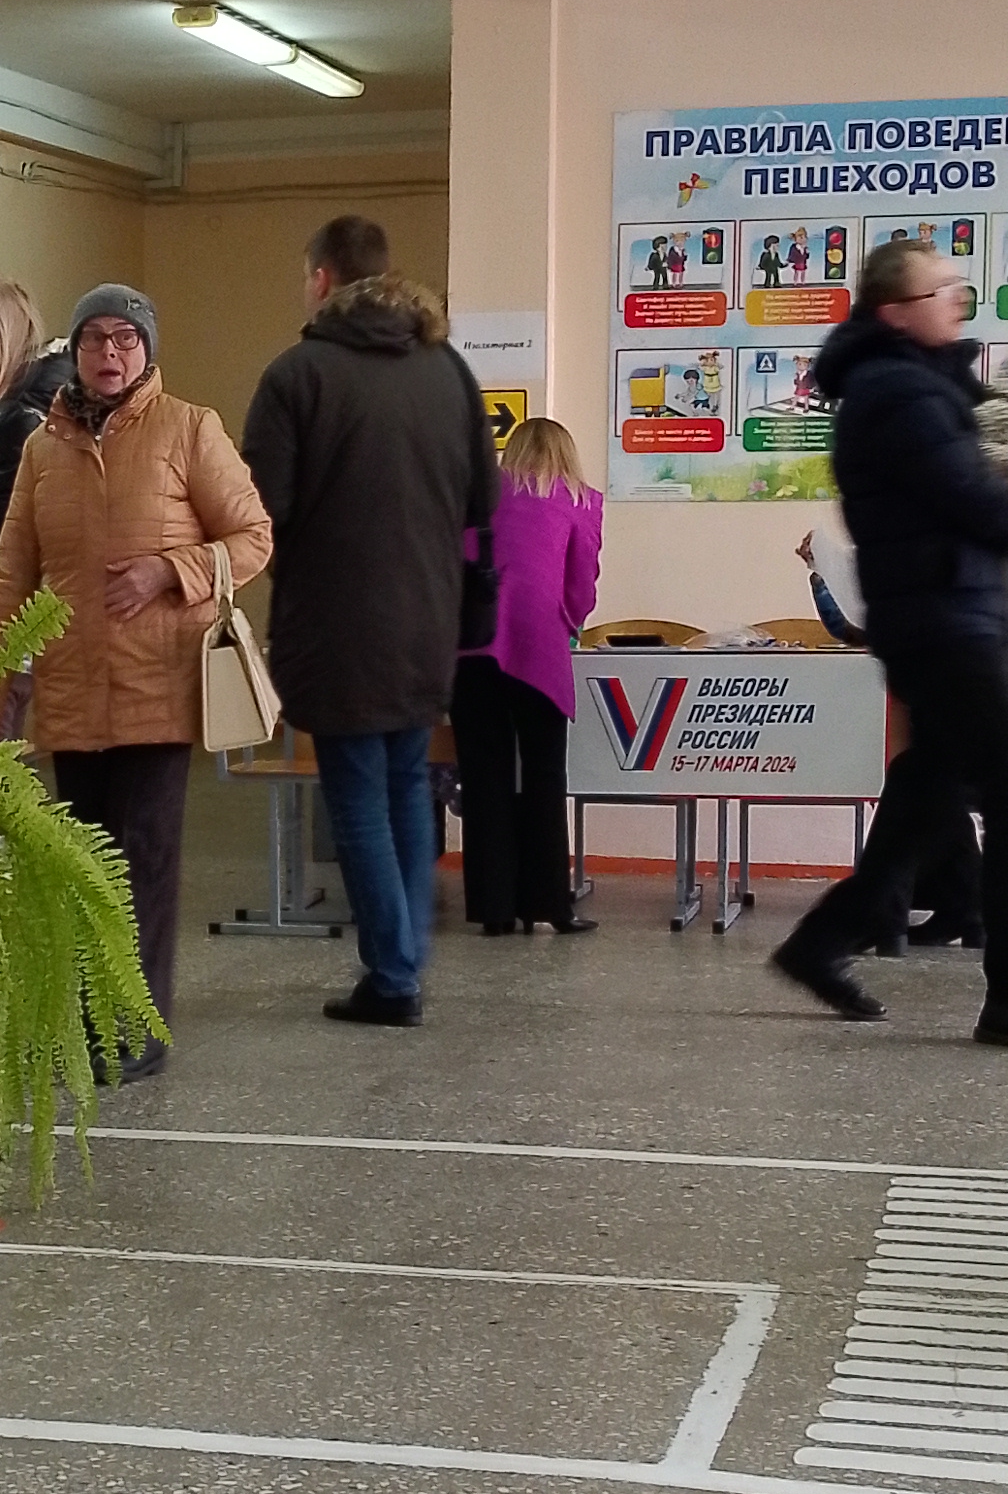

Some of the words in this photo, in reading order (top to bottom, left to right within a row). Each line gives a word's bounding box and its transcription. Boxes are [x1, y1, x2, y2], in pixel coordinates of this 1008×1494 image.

[645, 124, 832, 157] ПРАВИЛА
[848, 116, 1008, 152] ПОВЕДЕ
[744, 161, 996, 196] ПЕШЕХОДОВ
[697, 677, 789, 697] ВЫБОРЫ
[687, 704, 815, 725] ПРЕЗИДЕНТА
[677, 730, 760, 750] РОССИИ
[710, 755, 759, 772] МАРТА
[760, 755, 797, 772] 2024
